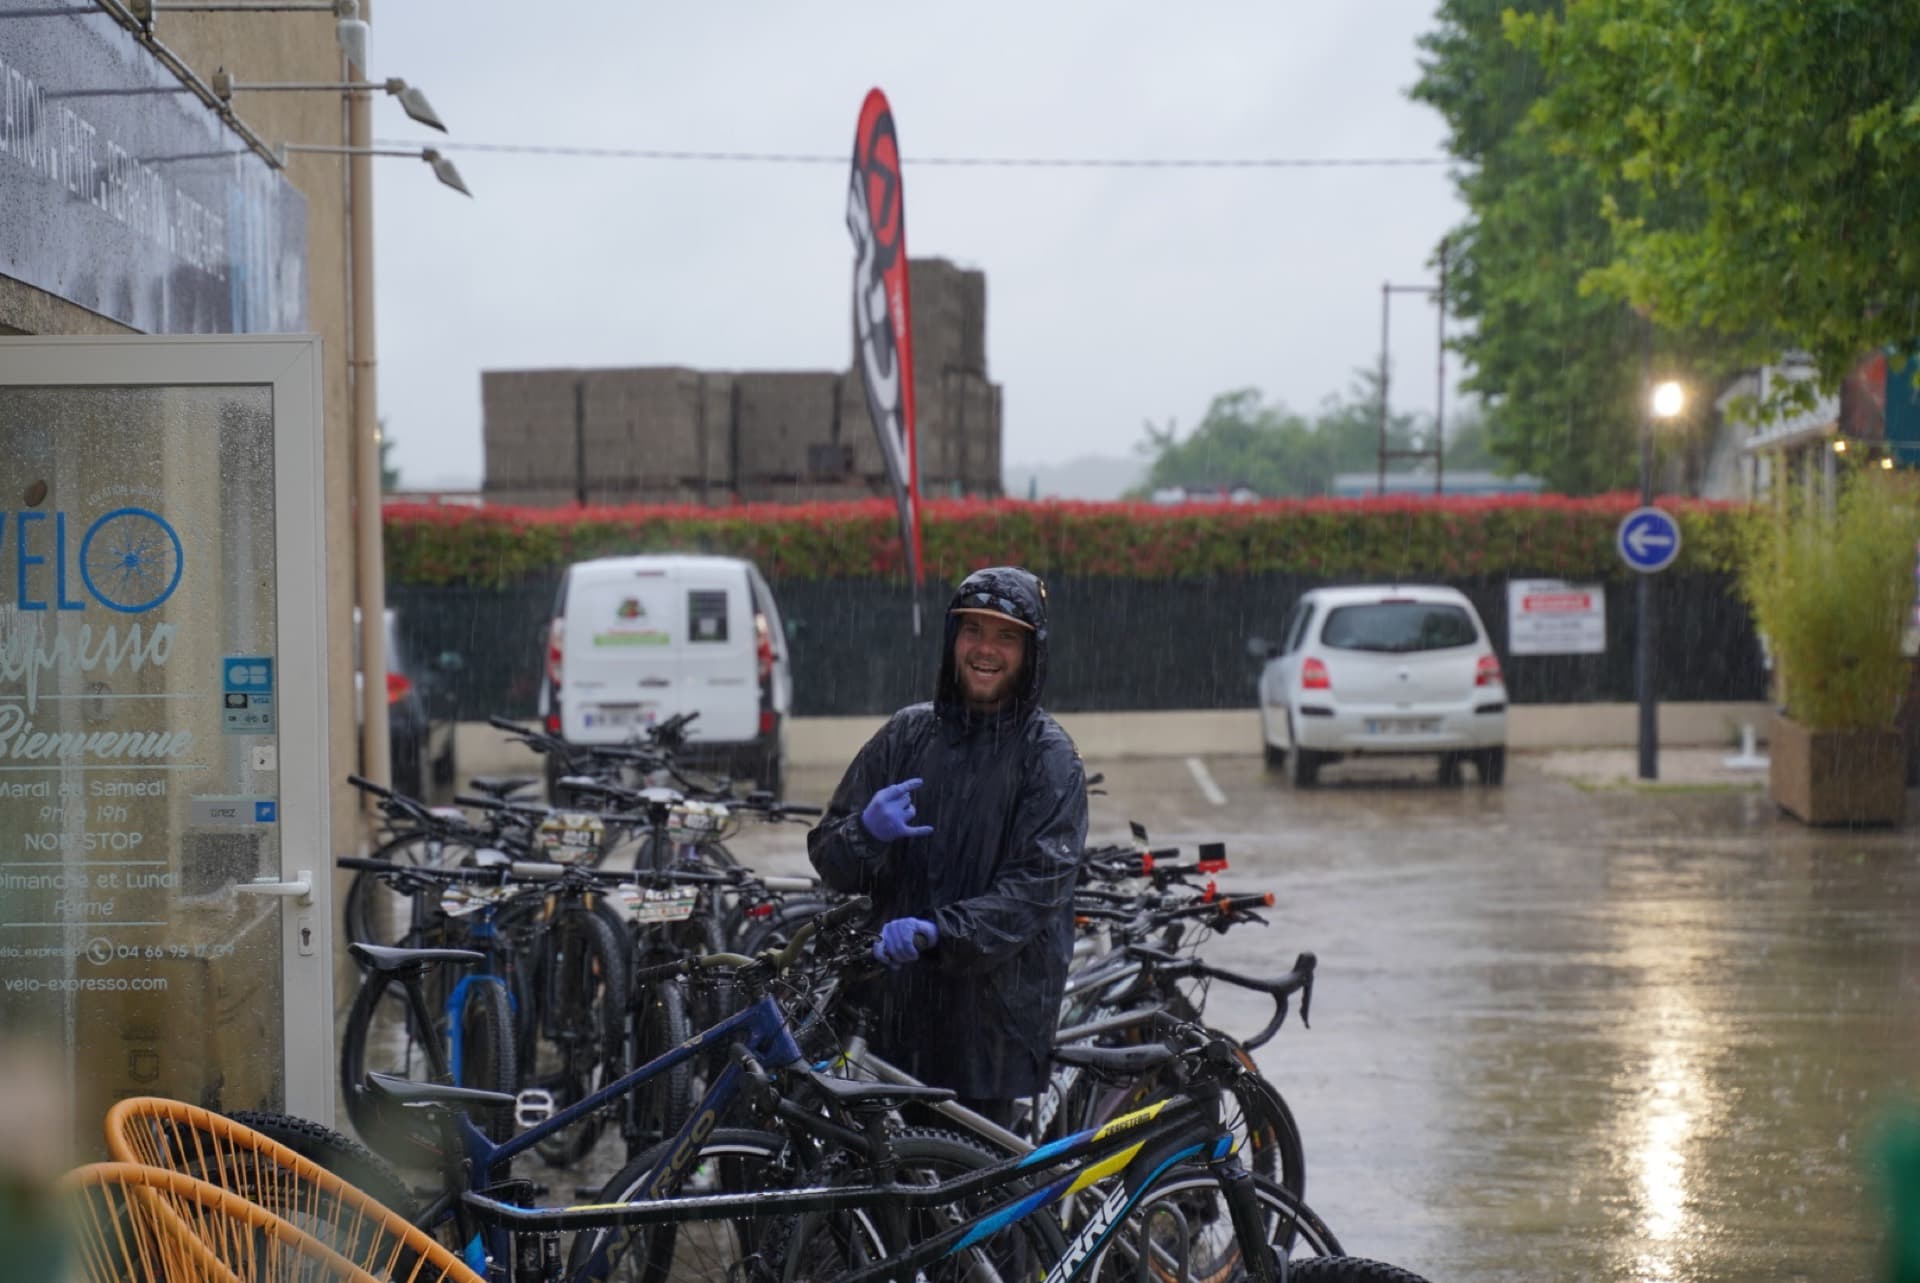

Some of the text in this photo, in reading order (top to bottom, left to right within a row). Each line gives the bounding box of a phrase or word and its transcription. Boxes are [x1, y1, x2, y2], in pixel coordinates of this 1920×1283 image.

[90, 781, 166, 797] Samedi
[83, 832, 143, 850] STOP
[97, 872, 119, 889] et
[126, 871, 178, 889] Lundi
[117, 946, 139, 959] 04
[144, 946, 164, 959] 66
